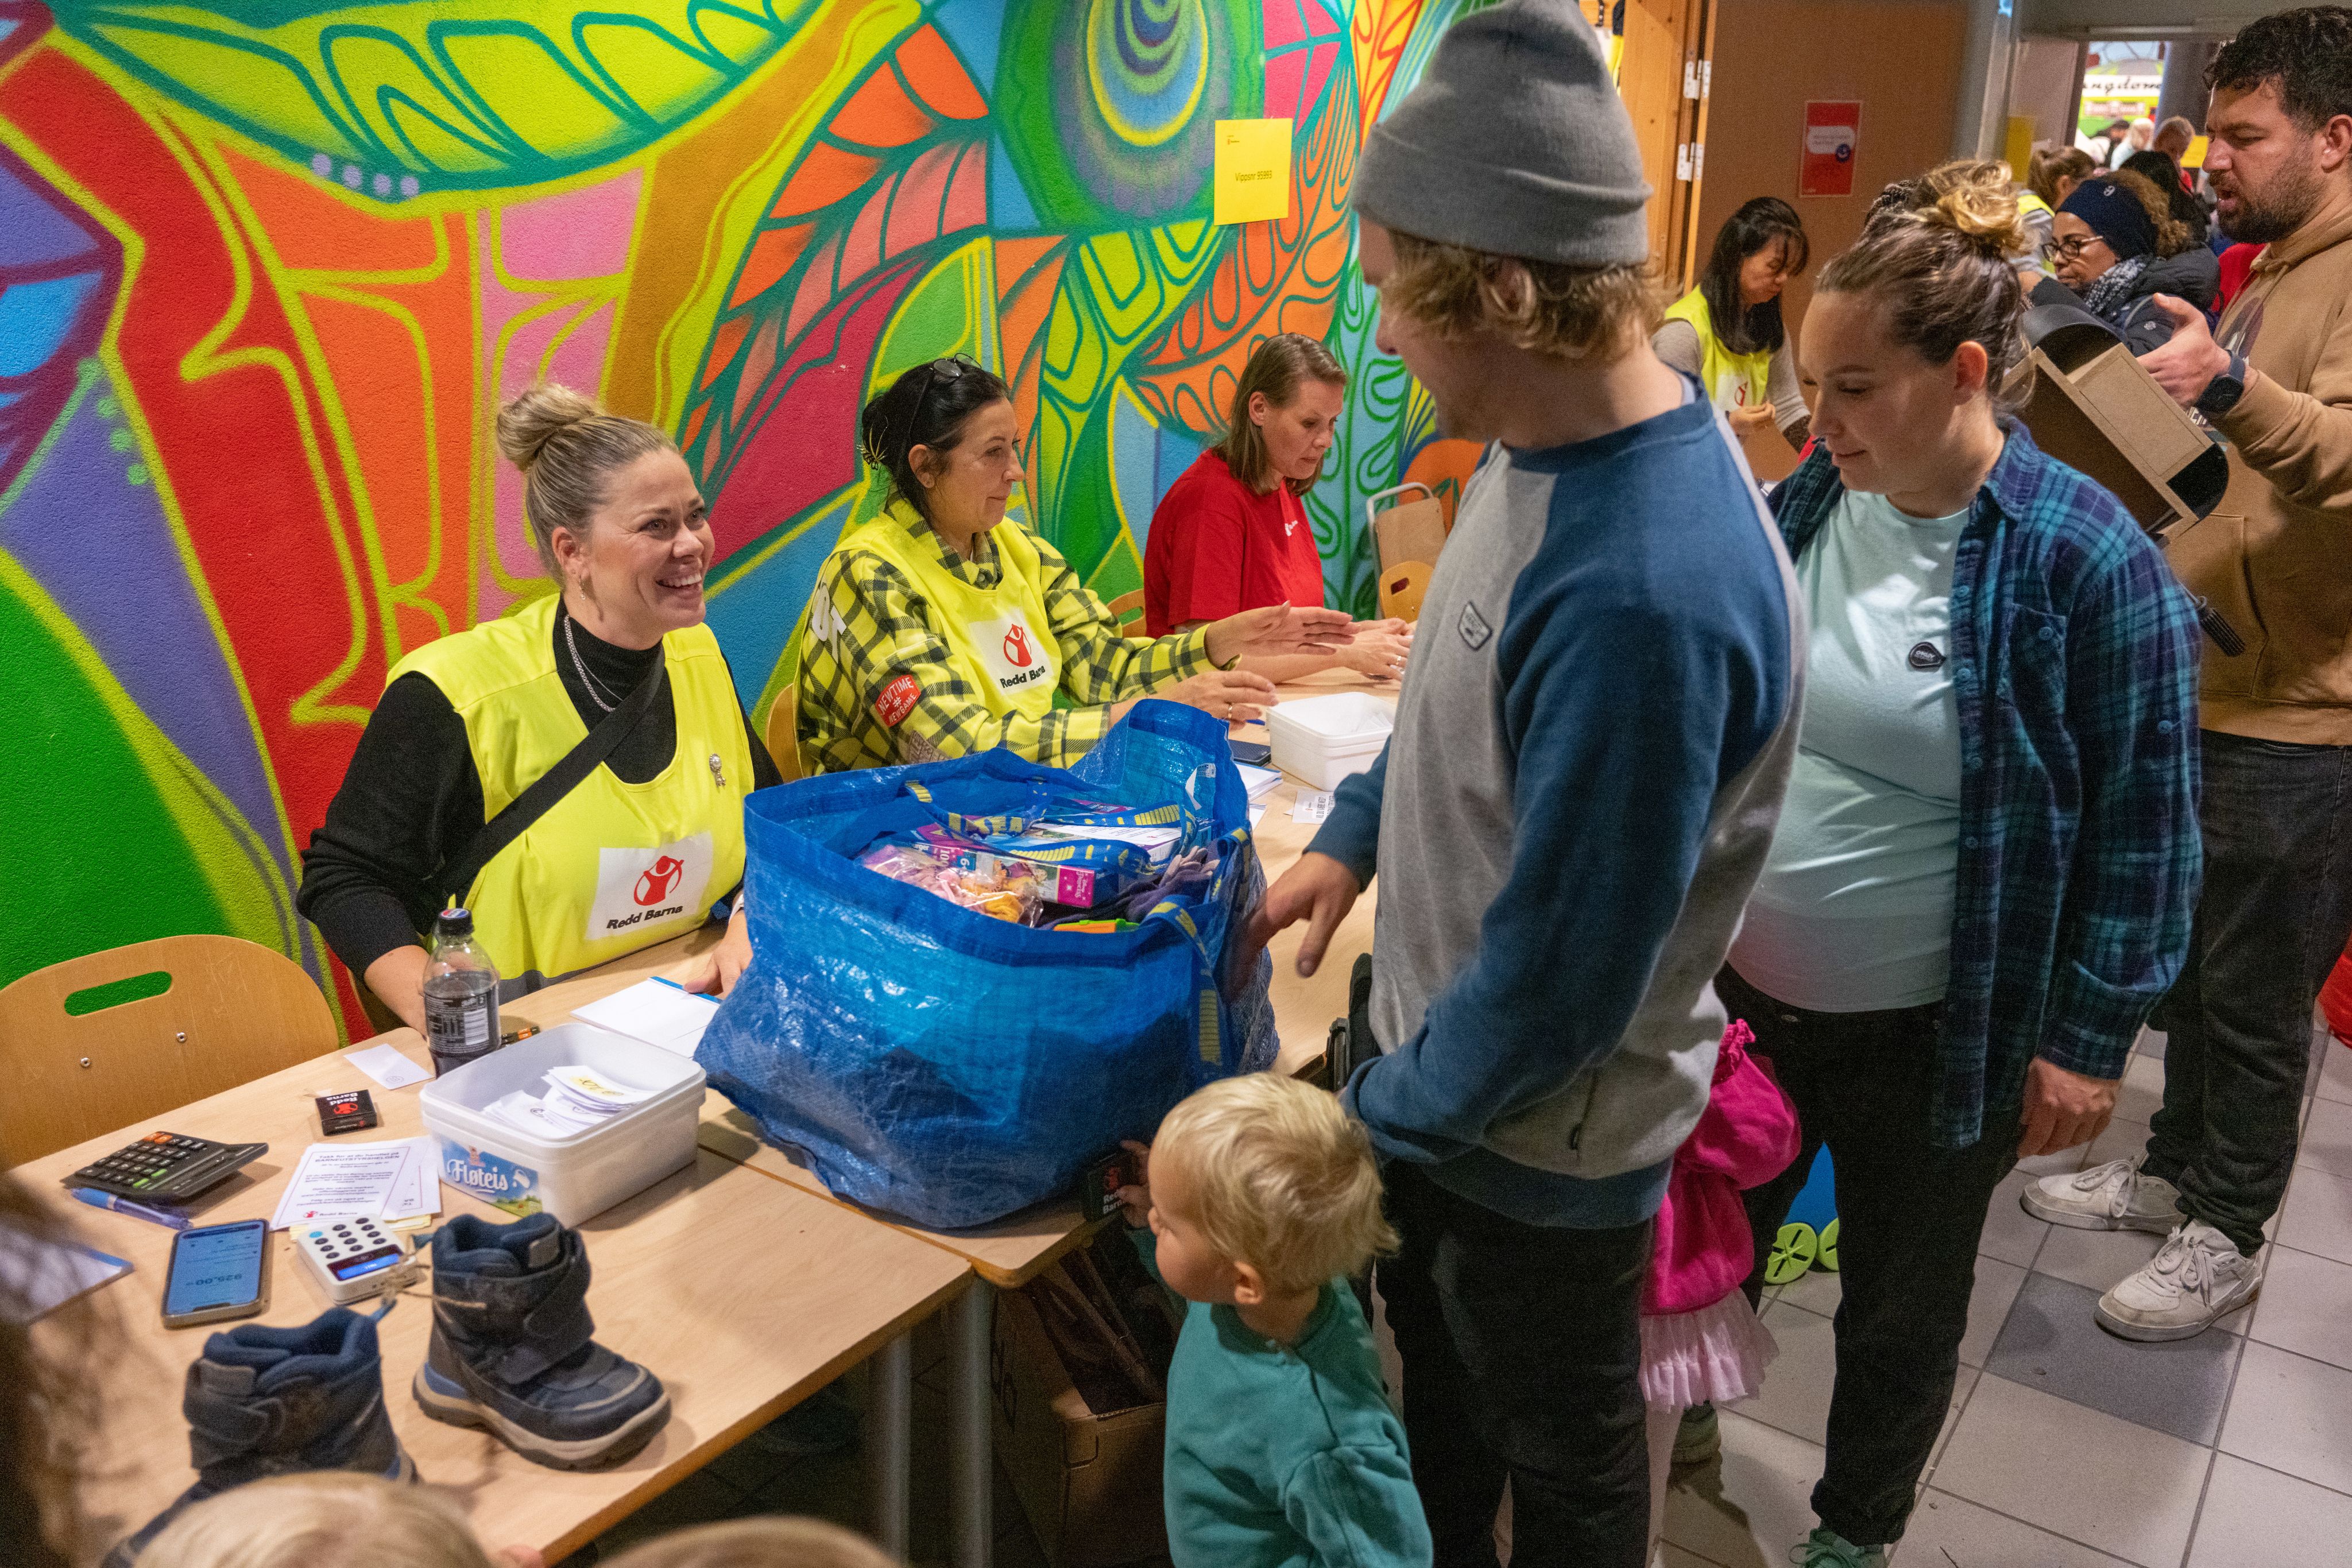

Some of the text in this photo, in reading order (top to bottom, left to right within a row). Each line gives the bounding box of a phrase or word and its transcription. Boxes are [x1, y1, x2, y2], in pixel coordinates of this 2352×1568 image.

[1000, 672, 1027, 688] Redd
[877, 677, 914, 715] NEWTIME
[889, 692, 916, 725] NEWGAME
[606, 905, 684, 930] Redd Barna
[326, 1092, 358, 1101] Barna
[330, 1097, 358, 1106] Redd
[447, 1159, 509, 1191] Fløteis
